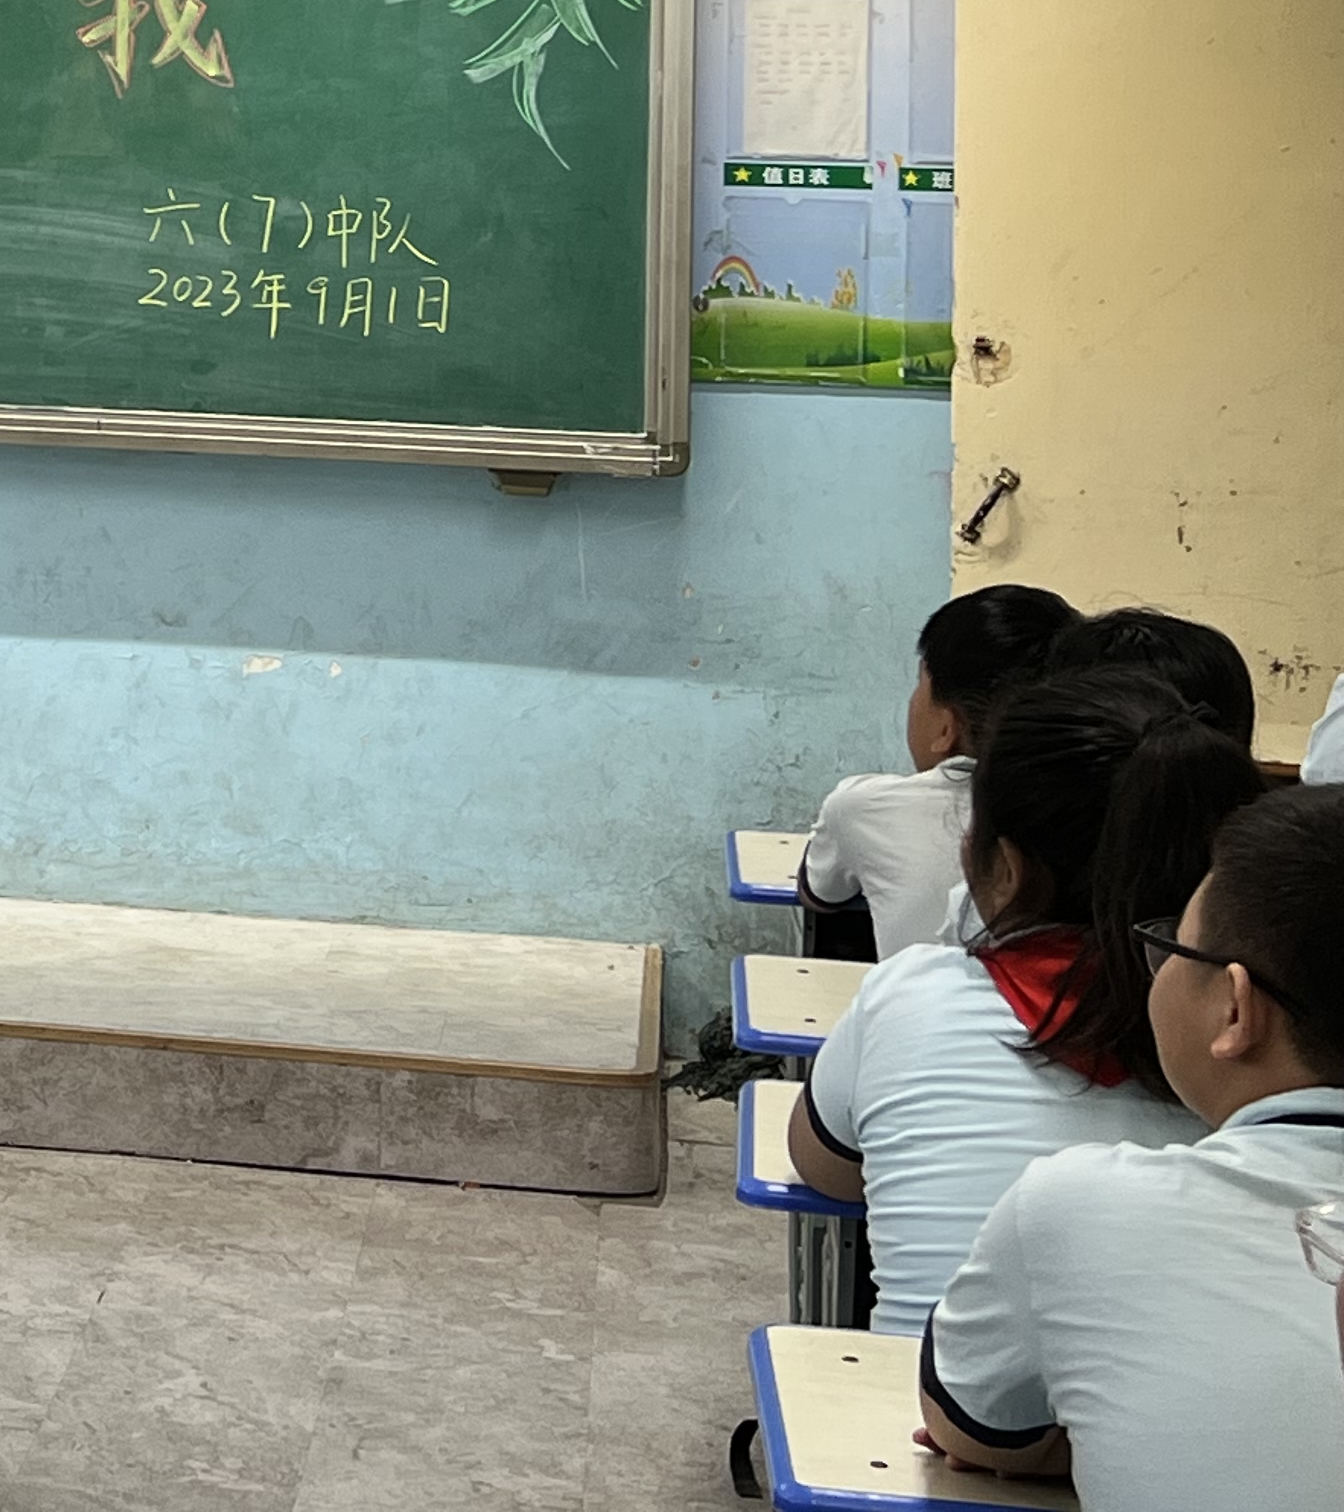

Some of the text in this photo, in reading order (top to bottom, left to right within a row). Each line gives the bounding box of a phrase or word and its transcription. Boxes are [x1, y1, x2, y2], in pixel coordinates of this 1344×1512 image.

[762, 167, 830, 185] 值日表
[137, 269, 450, 339] 2023年9月1日
